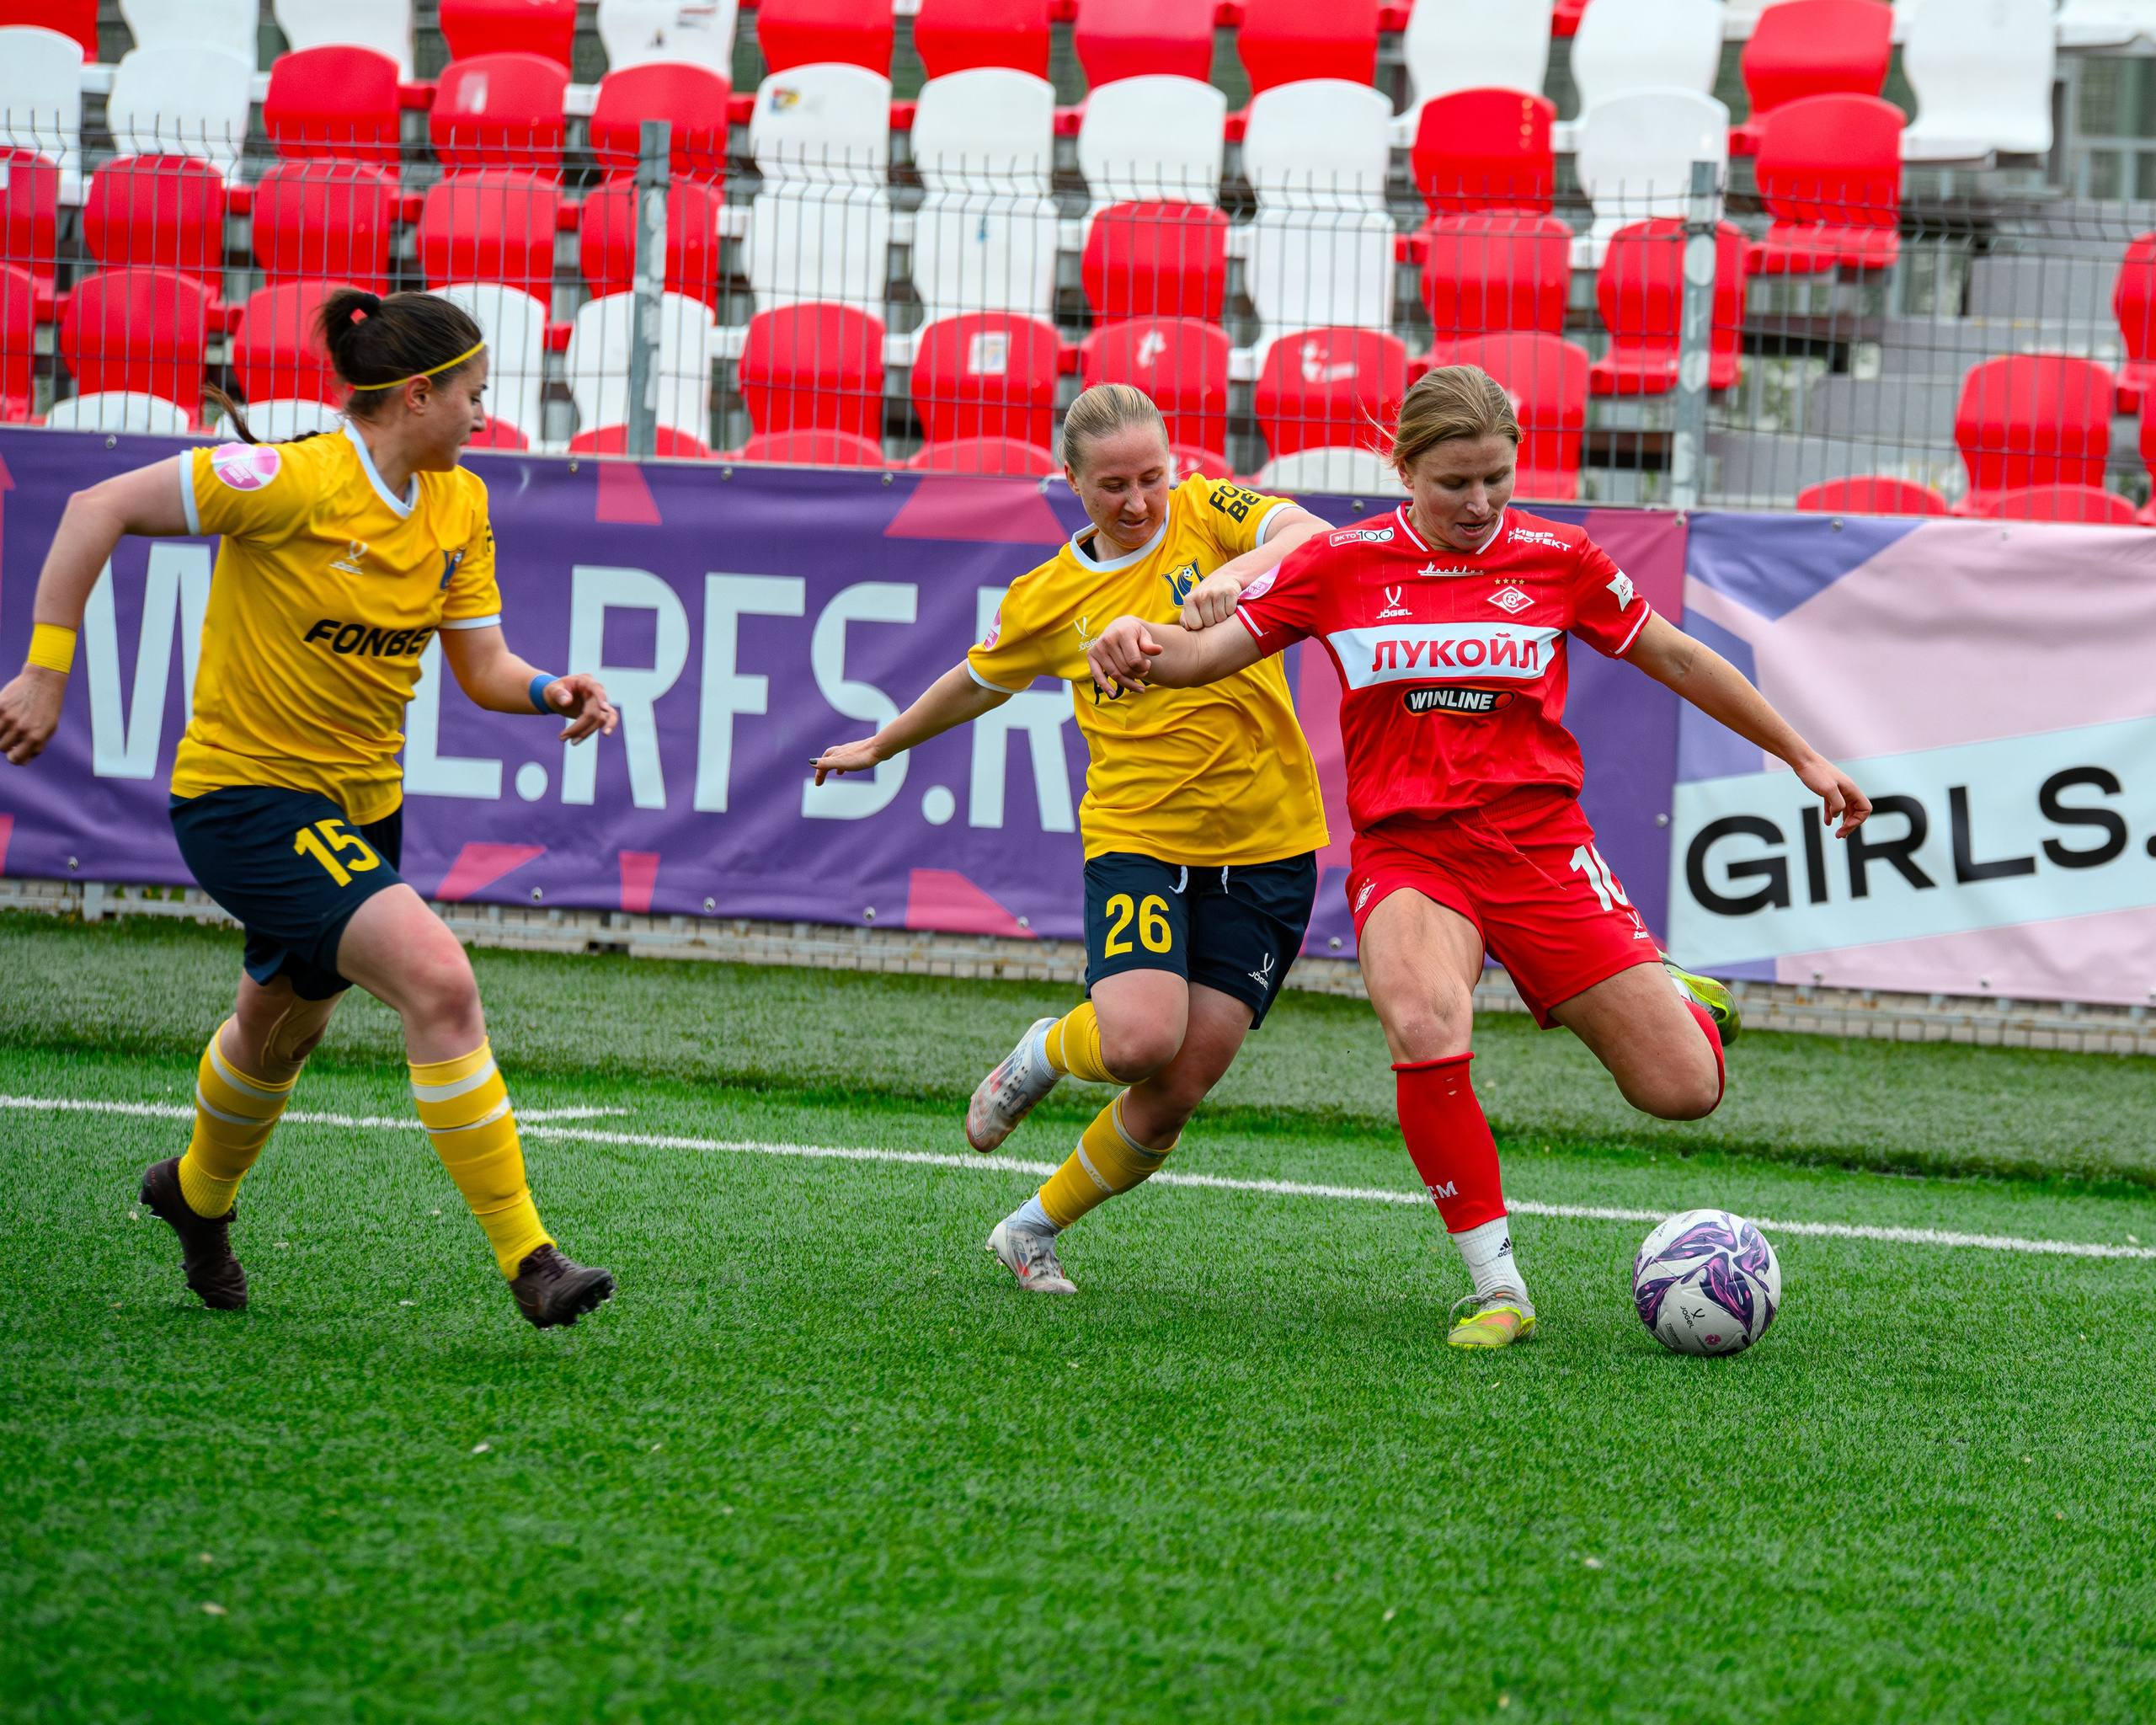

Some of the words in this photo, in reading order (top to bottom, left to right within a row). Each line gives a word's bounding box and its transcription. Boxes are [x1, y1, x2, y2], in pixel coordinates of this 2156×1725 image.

[1376, 608, 1412, 619] JÖGEL
[303, 618, 438, 657] FONBE
[1372, 633, 1539, 672] ЛУКОЙЛ
[1411, 690, 1493, 710] WINLINE
[294, 819, 381, 887] 15
[1104, 893, 1172, 959] 26
